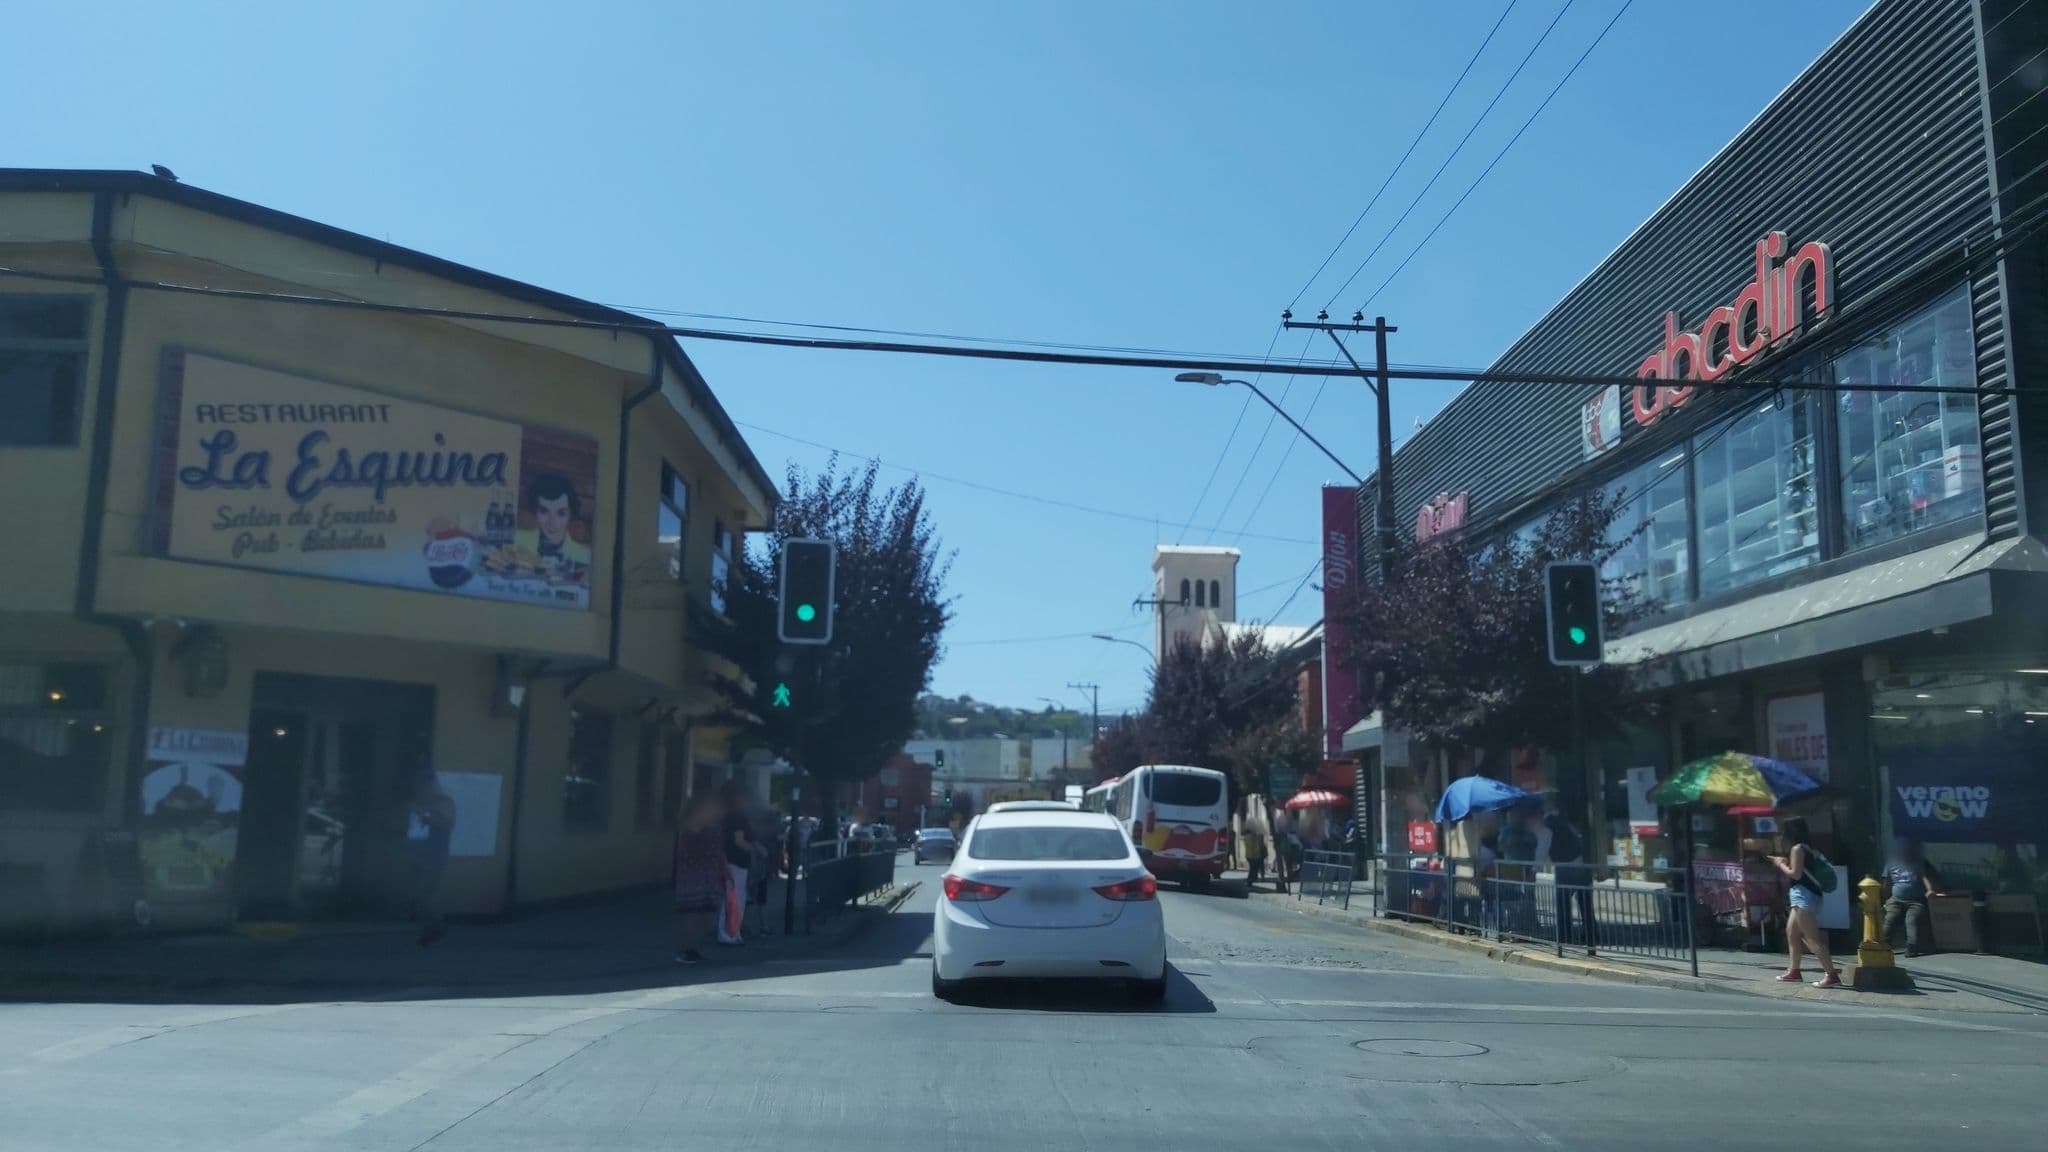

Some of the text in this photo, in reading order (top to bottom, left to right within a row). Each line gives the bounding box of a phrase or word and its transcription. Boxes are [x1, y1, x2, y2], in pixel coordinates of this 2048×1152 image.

[1632, 230, 1835, 426] abcdin
[196, 403, 391, 424] RESTAURANT
[179, 429, 507, 503] La Esquina
[212, 503, 397, 531] Salón de Eventos
[232, 531, 280, 558] Pub
[301, 529, 386, 553] Bebidas
[1327, 531, 1354, 590] Dijon
[1811, 735, 1826, 761] DE
[1896, 785, 1990, 801] verano
